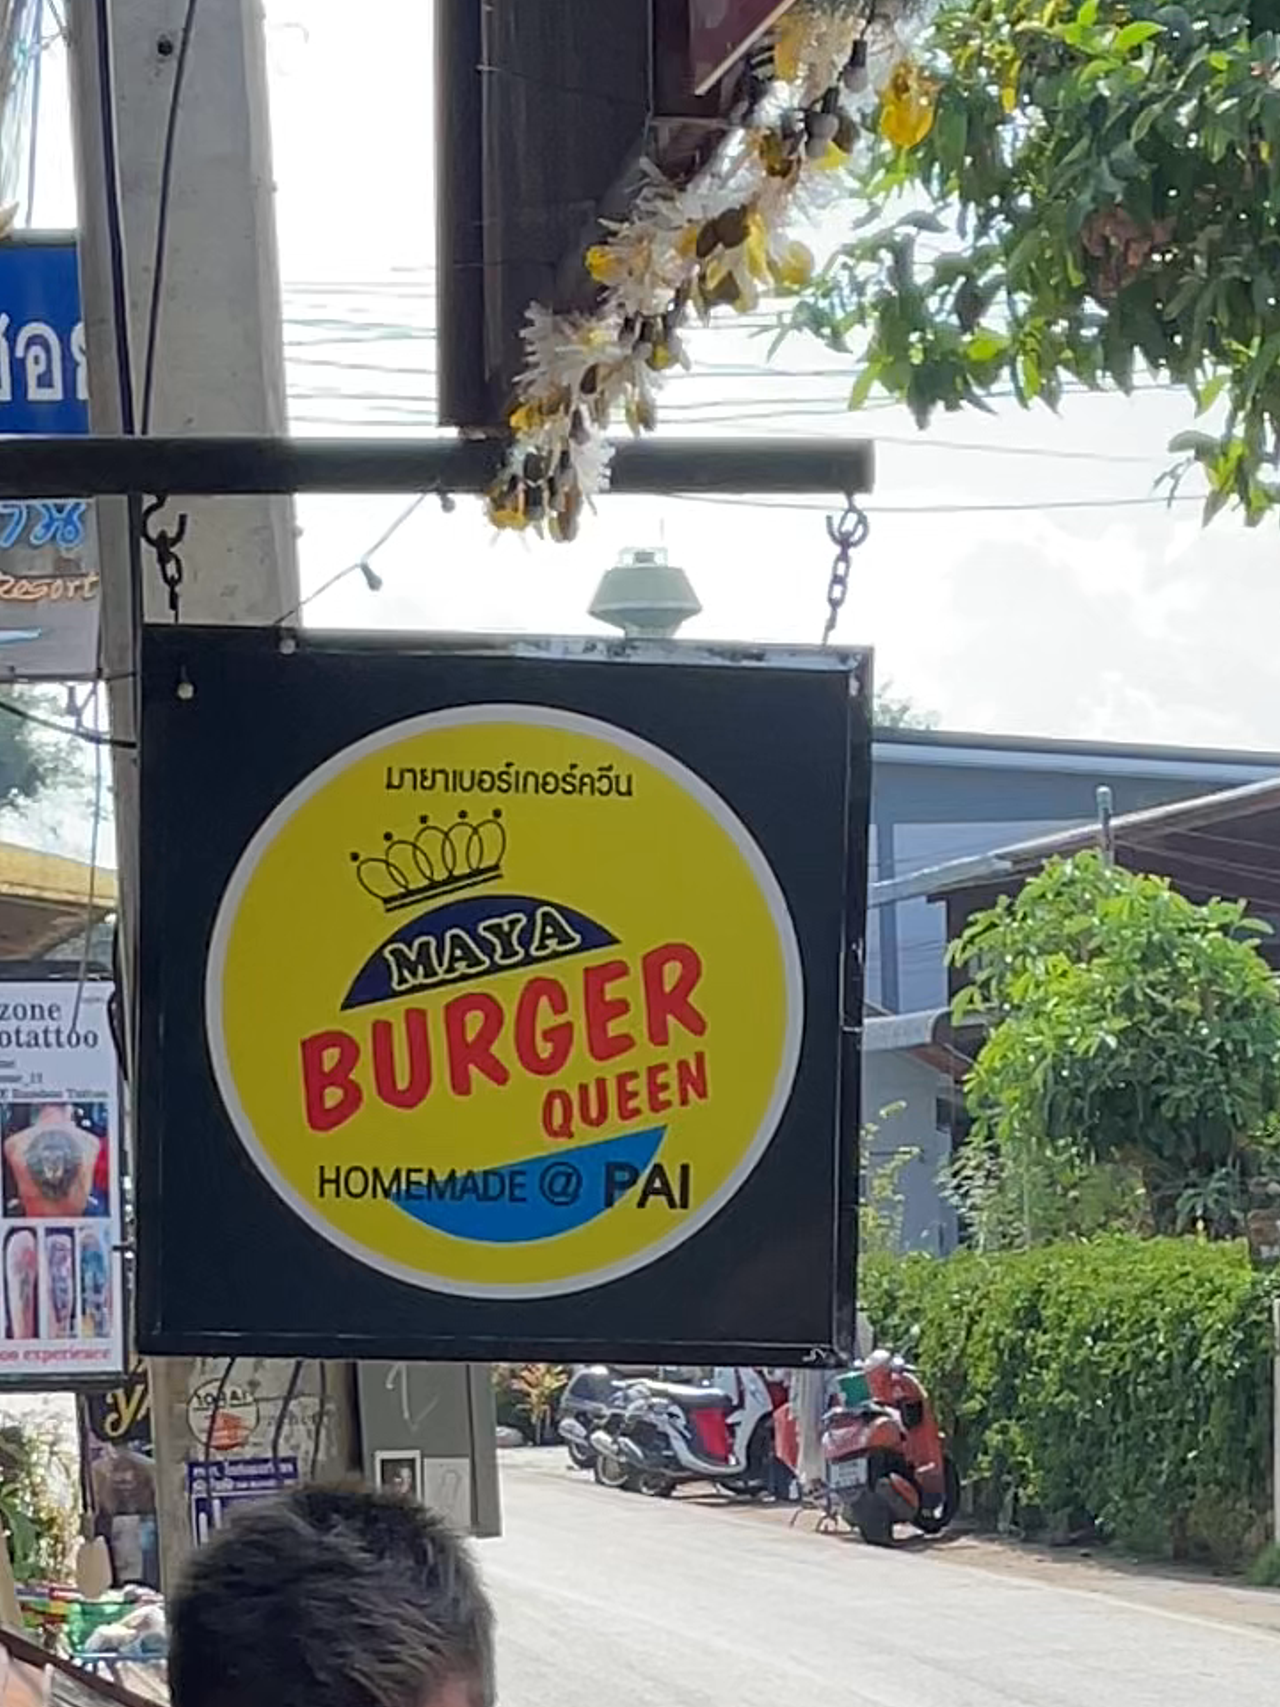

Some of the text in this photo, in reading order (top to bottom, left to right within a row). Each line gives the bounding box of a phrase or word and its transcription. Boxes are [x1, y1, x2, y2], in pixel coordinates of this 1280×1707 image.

[385, 761, 633, 798] มายาเบอร์เกอร์ควีน
[384, 905, 580, 992] MAYA
[300, 943, 708, 1133] BURGER
[541, 1051, 708, 1140] QUEEN
[320, 1163, 691, 1210] HOMEMADE @ PAI
